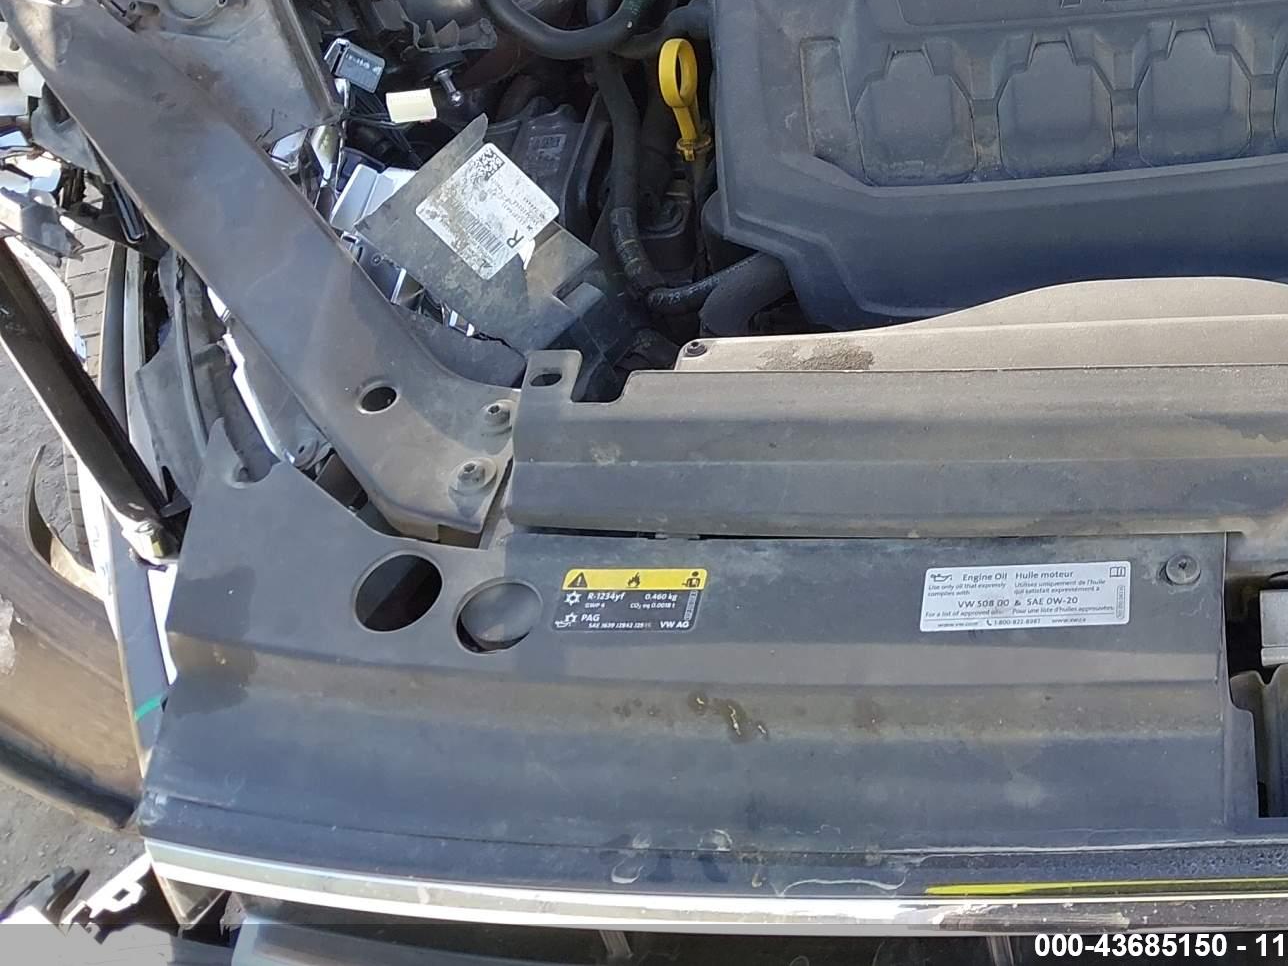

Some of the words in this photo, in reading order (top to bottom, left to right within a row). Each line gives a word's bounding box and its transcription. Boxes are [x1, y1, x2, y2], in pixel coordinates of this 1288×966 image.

[963, 573, 992, 583] Engine
[994, 572, 1007, 580] Oil
[1015, 571, 1038, 580] Huile
[1040, 570, 1074, 579] moteur
[587, 592, 626, 602] R-1234yf
[645, 593, 667, 601] 0.460
[668, 593, 678, 602] kg
[958, 600, 976, 608] VW
[977, 599, 995, 607] 508
[996, 599, 1010, 607] 00
[1026, 598, 1044, 606] SAE
[1046, 596, 1078, 605] 0W-20
[580, 614, 600, 622] PAG
[659, 620, 675, 629] VW
[675, 620, 690, 629] AG
